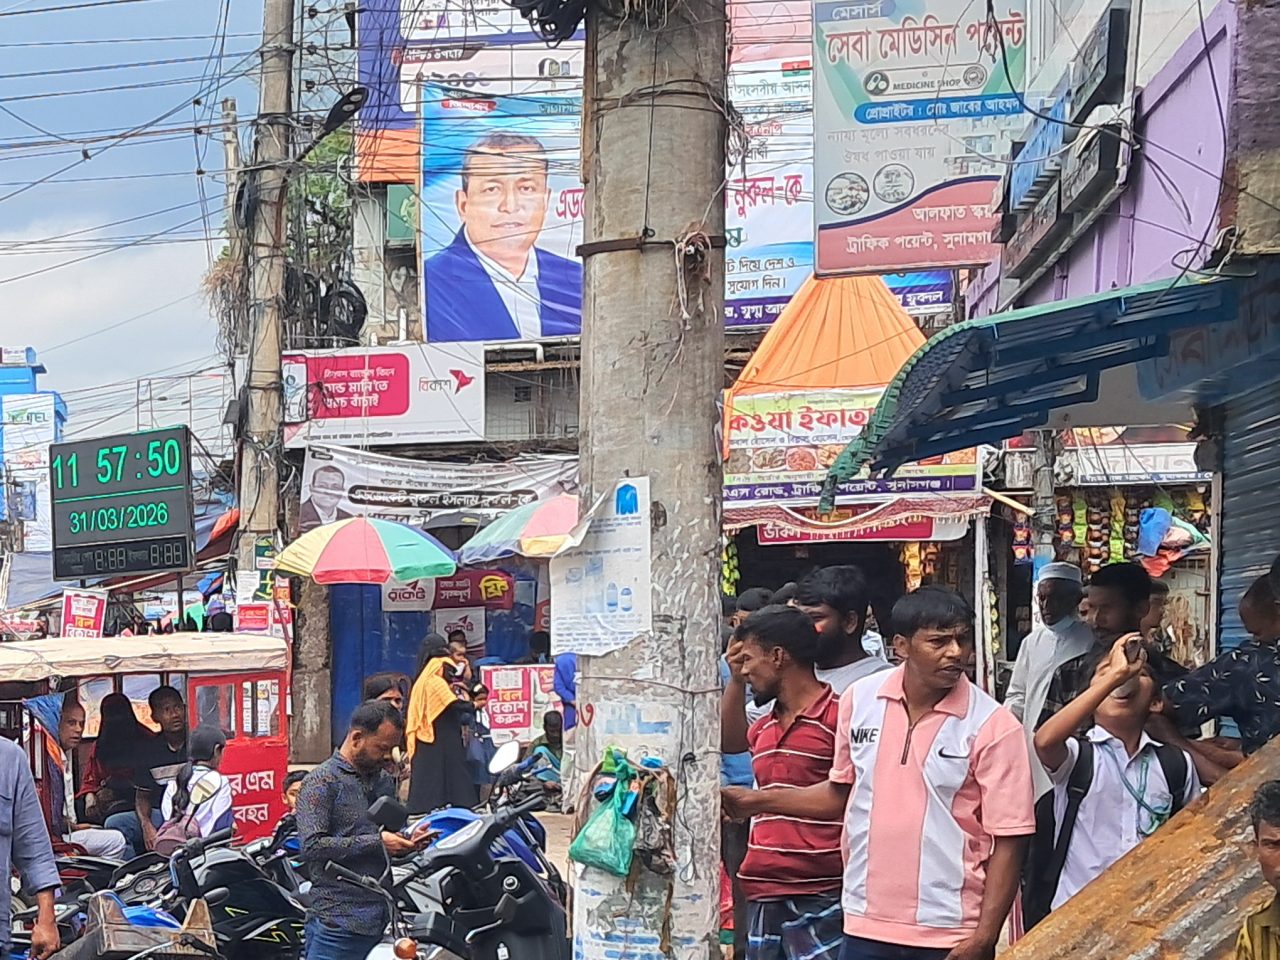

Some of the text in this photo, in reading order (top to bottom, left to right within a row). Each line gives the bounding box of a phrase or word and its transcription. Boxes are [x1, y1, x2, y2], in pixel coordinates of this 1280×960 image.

[826, 28, 873, 63] সেবা
[876, 15, 960, 59] মেডিসিন
[893, 79, 962, 91] MEDICINE SHOP
[912, 203, 995, 222] আলফাত স্কয়
[846, 234, 890, 254] ট্রাফিক
[894, 232, 938, 250] পয়েন্ট,
[729, 410, 793, 432] কওয়া
[52, 453, 79, 489] 11
[792, 479, 823, 496] ট্রাফি
[70, 502, 169, 534] 31/03/2026
[498, 688, 524, 701] বিল
[488, 699, 529, 714] বিকাশ
[850, 728, 879, 744] NIKE
[228, 770, 275, 796] র.এম
[232, 803, 269, 825] বহন
